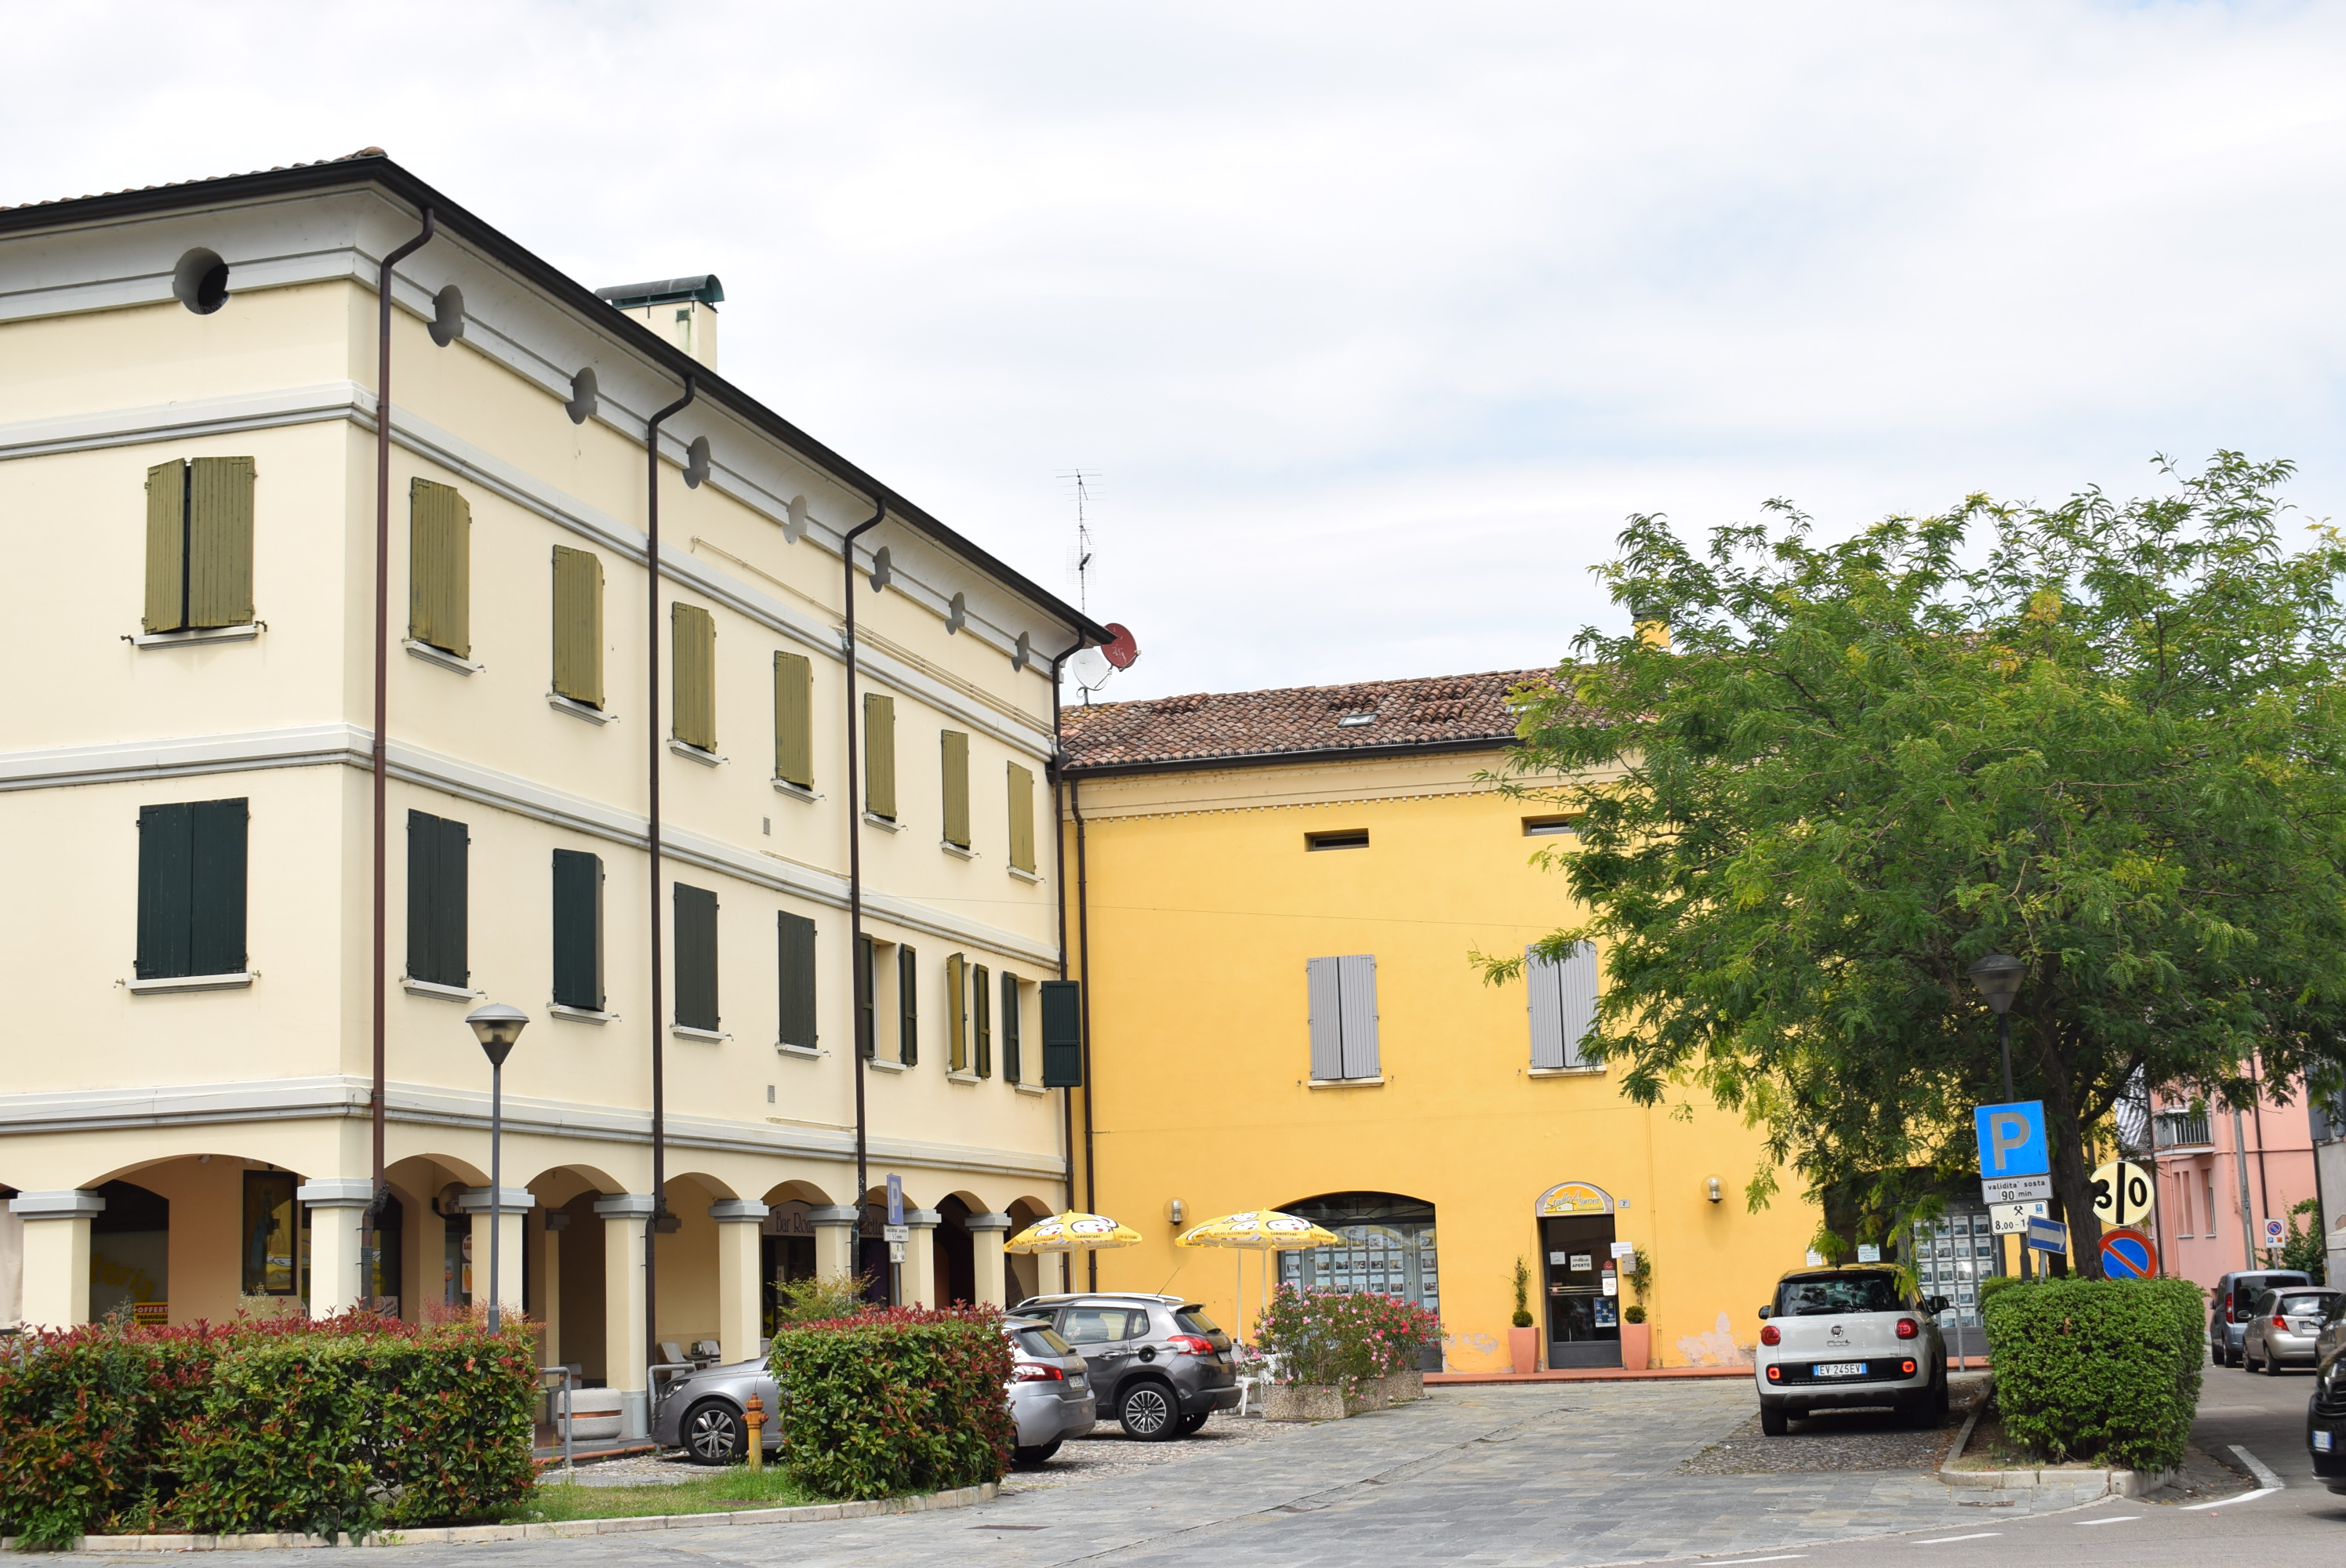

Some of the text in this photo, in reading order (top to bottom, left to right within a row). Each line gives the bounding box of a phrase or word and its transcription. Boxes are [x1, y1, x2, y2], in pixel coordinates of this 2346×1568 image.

[1989, 1111, 2030, 1171] P
[891, 1181, 900, 1219] P
[2001, 1190, 2015, 1200] 90
[775, 1210, 790, 1232] Bar
[794, 1212, 815, 1233] Rom
[1819, 1364, 1861, 1375] EV 245EV
